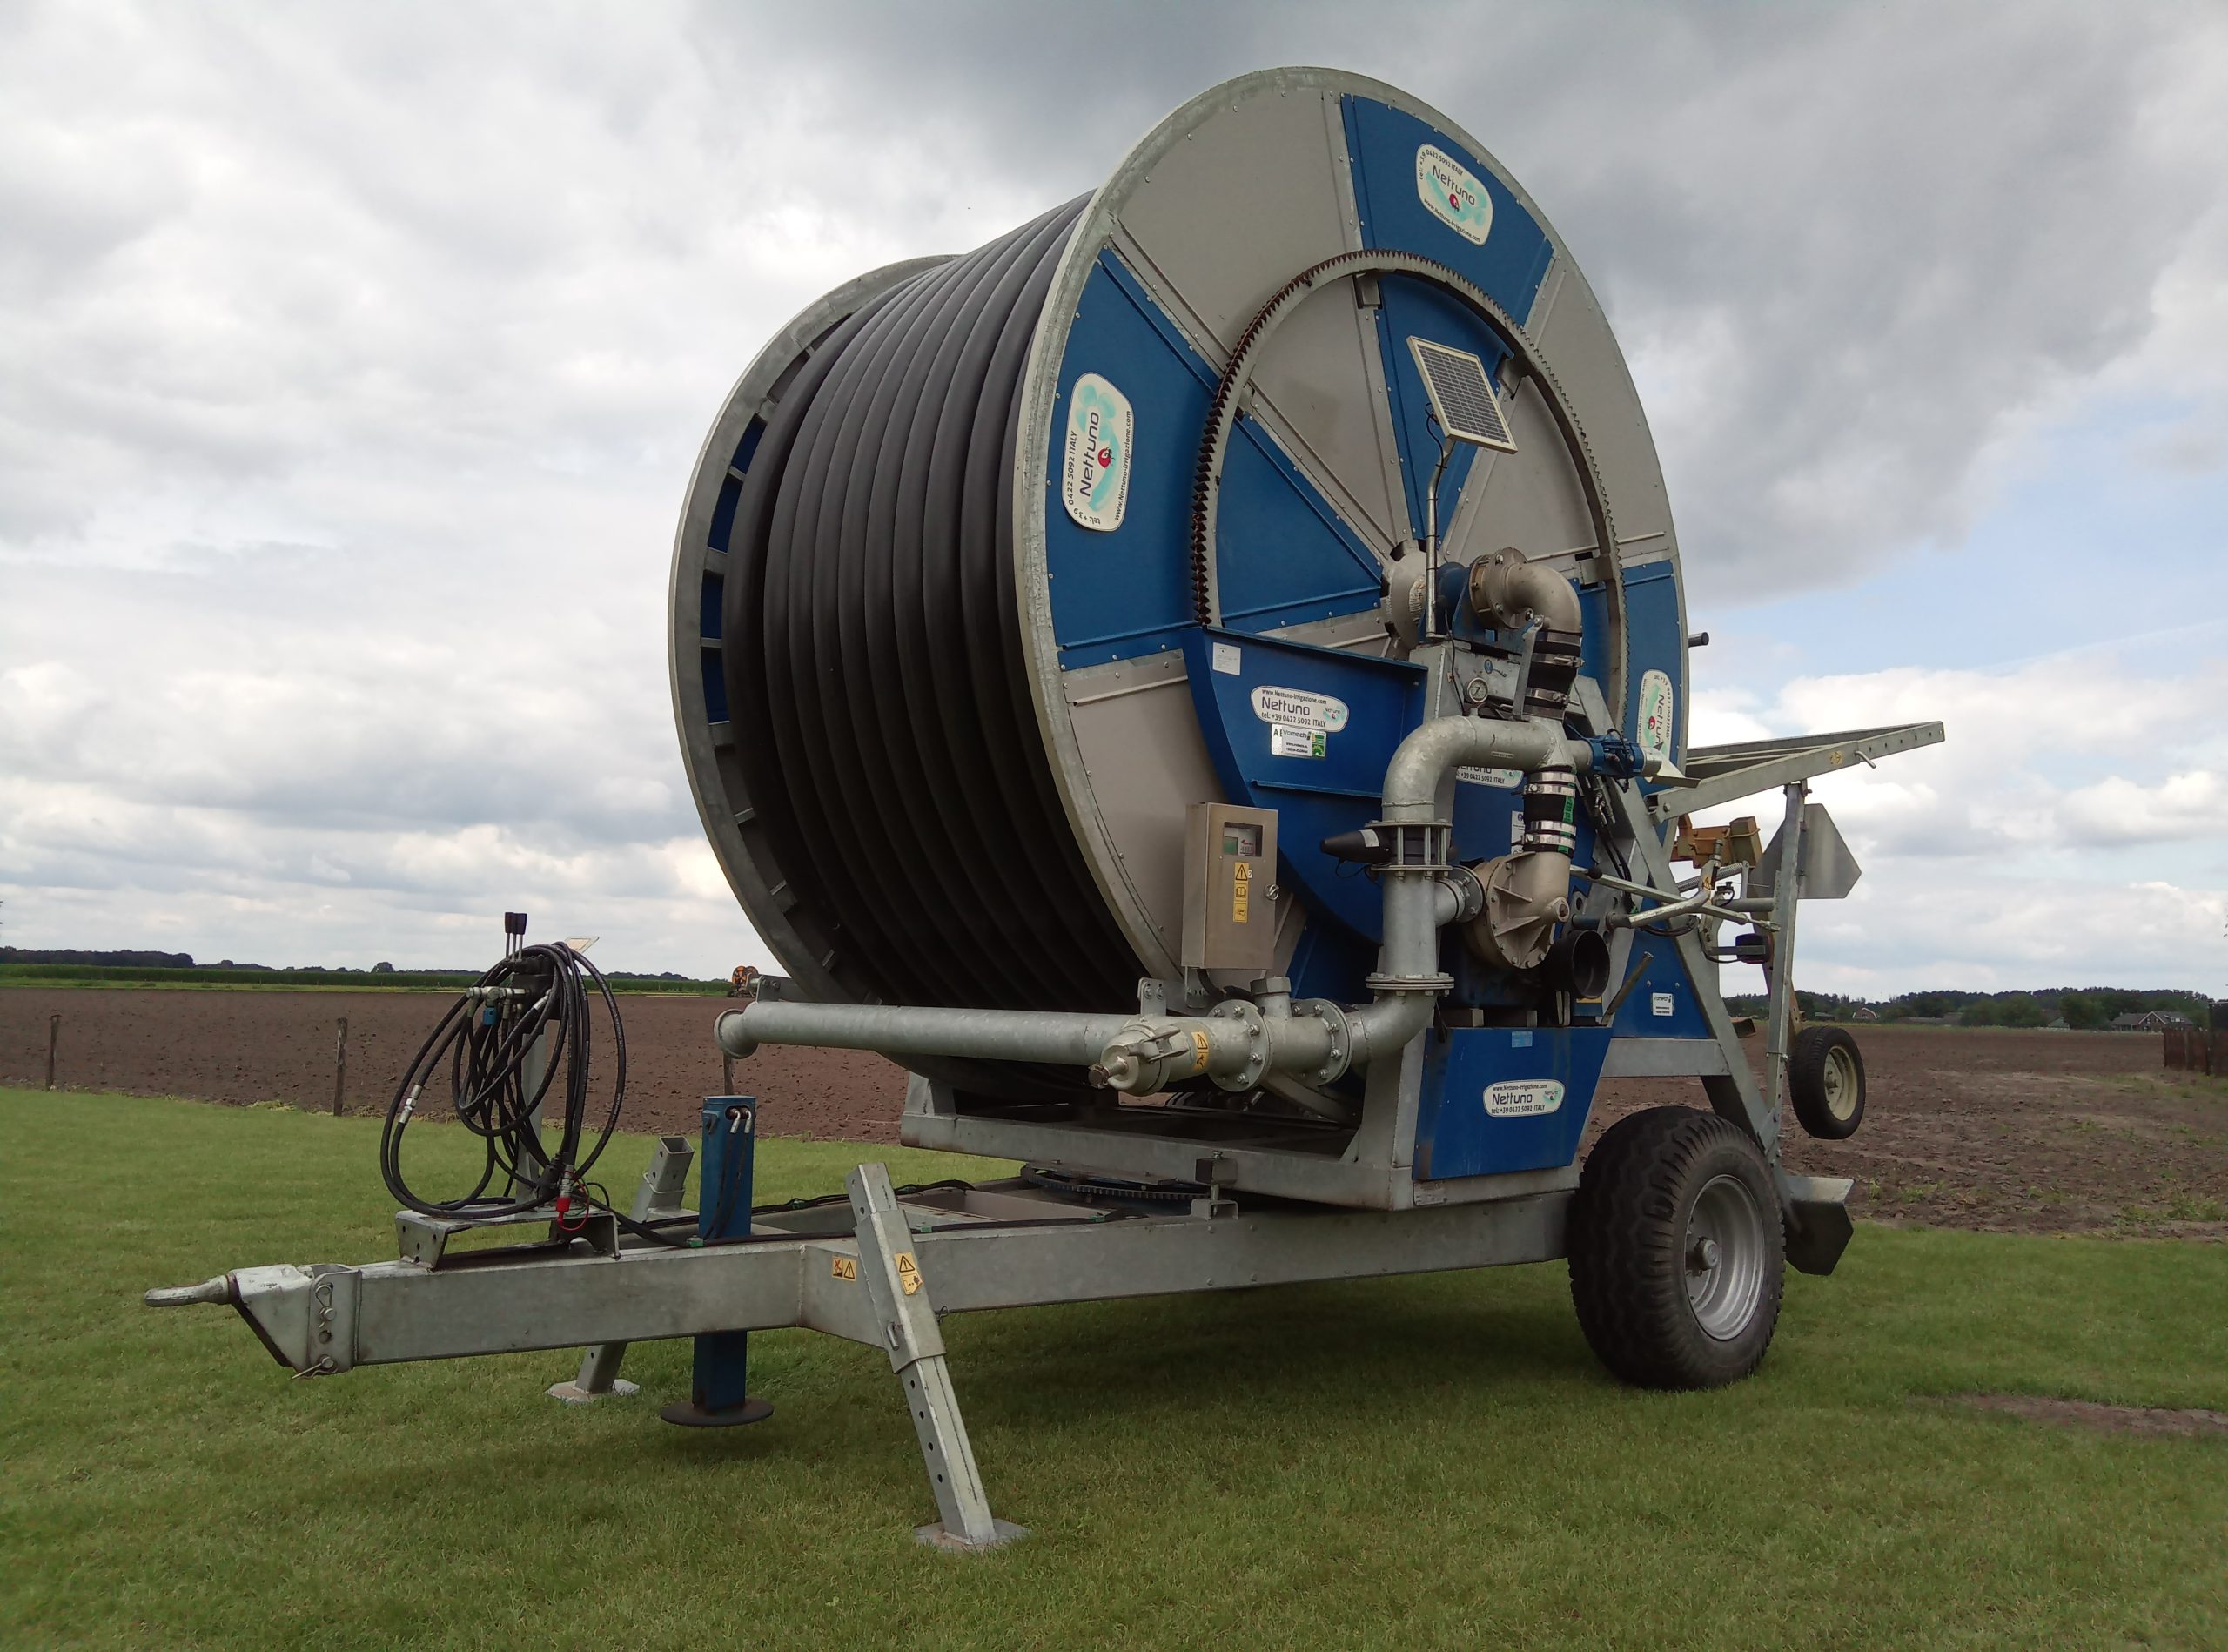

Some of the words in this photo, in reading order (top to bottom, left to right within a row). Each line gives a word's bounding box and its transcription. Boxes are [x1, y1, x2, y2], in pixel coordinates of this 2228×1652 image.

[1432, 165, 1475, 206] Nettuno
[1069, 430, 1077, 455] ITALY
[1079, 411, 1099, 497] Nettuno
[1114, 410, 1131, 520] www.Nettuno-Irrigazione.com
[1261, 688, 1327, 704] www.Nettuno-Irrigazione.com
[1261, 696, 1311, 716] Nettuno
[1282, 715, 1297, 723] 0422
[1312, 719, 1326, 728] ITALY
[1654, 694, 1665, 744] Nettun
[1492, 1092, 1533, 1105] Nettuno
